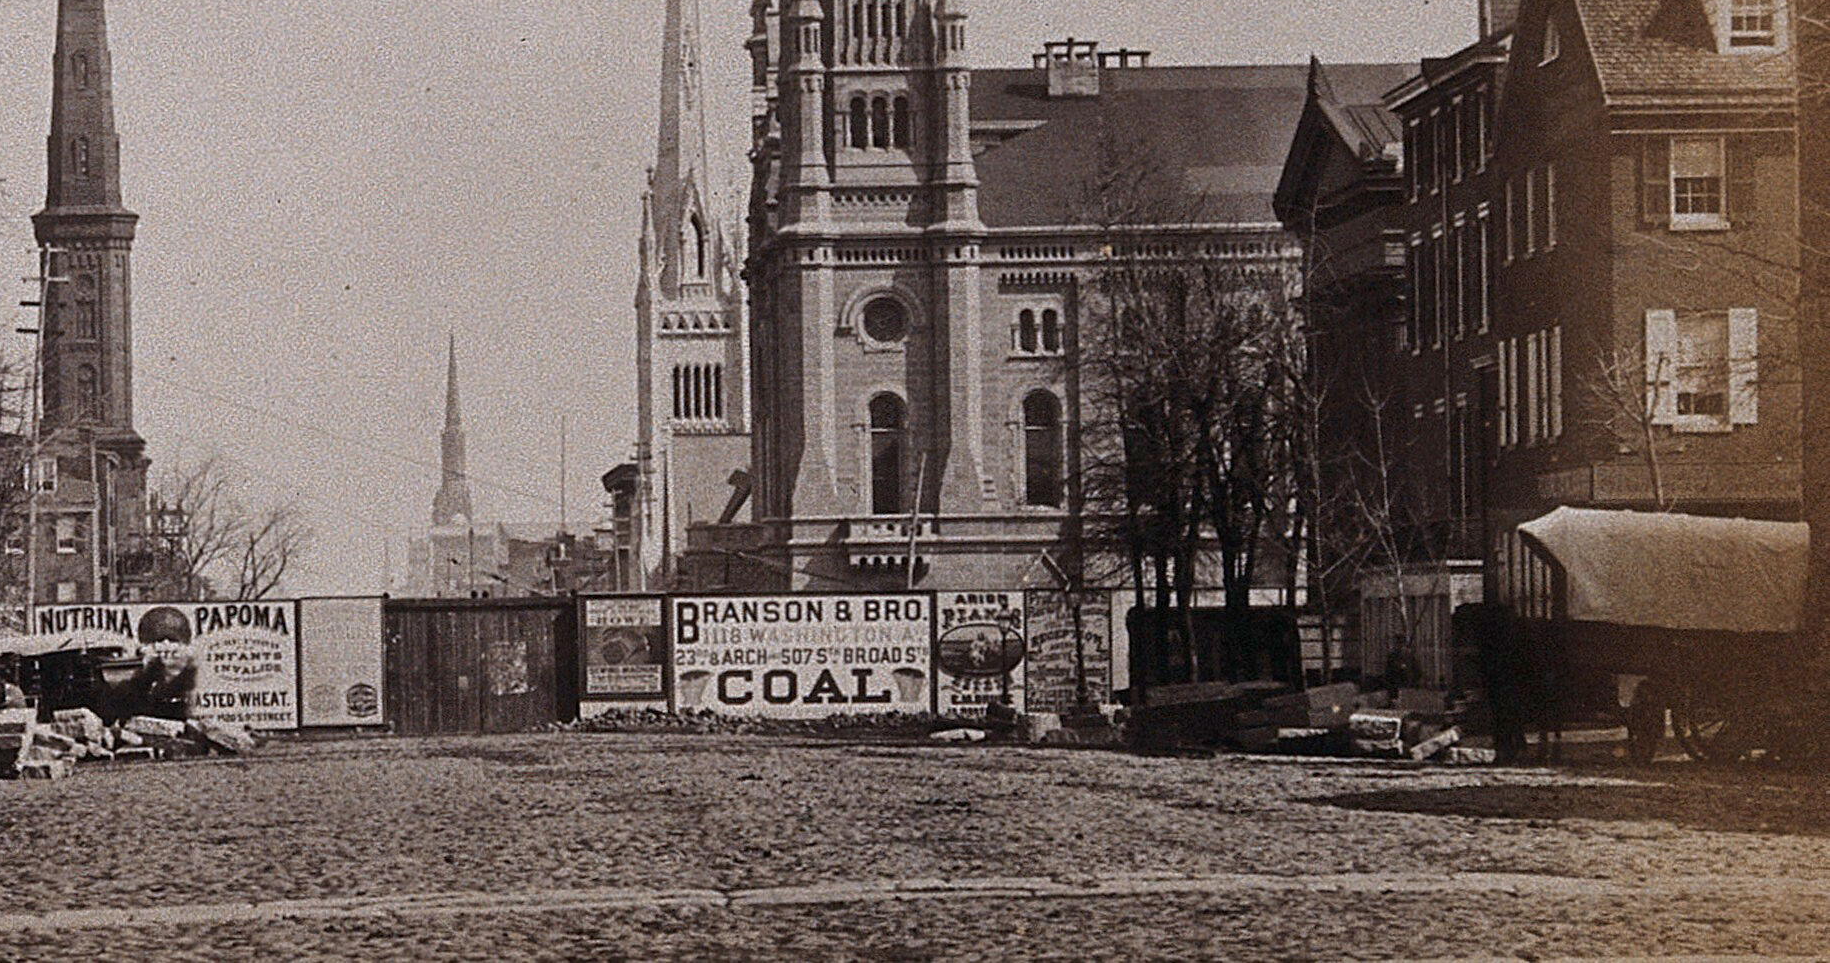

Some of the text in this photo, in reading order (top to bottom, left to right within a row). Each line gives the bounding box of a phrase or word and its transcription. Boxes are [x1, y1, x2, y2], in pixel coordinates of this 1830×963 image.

[40, 607, 134, 637] NUTRINA
[196, 605, 289, 635] PAPOMA
[677, 600, 822, 644] BRANSON
[835, 600, 852, 621] &
[864, 600, 928, 622] BRO.
[942, 608, 1022, 629] PIANS
[207, 651, 282, 661] INFANTS
[709, 652, 719, 666] &
[722, 649, 767, 665] ARCH
[781, 648, 811, 665] 507
[843, 647, 901, 665] BROAD
[214, 664, 282, 674] INVALIDS
[717, 668, 891, 705] COAL
[195, 691, 290, 707] ASTED WHEAT.
